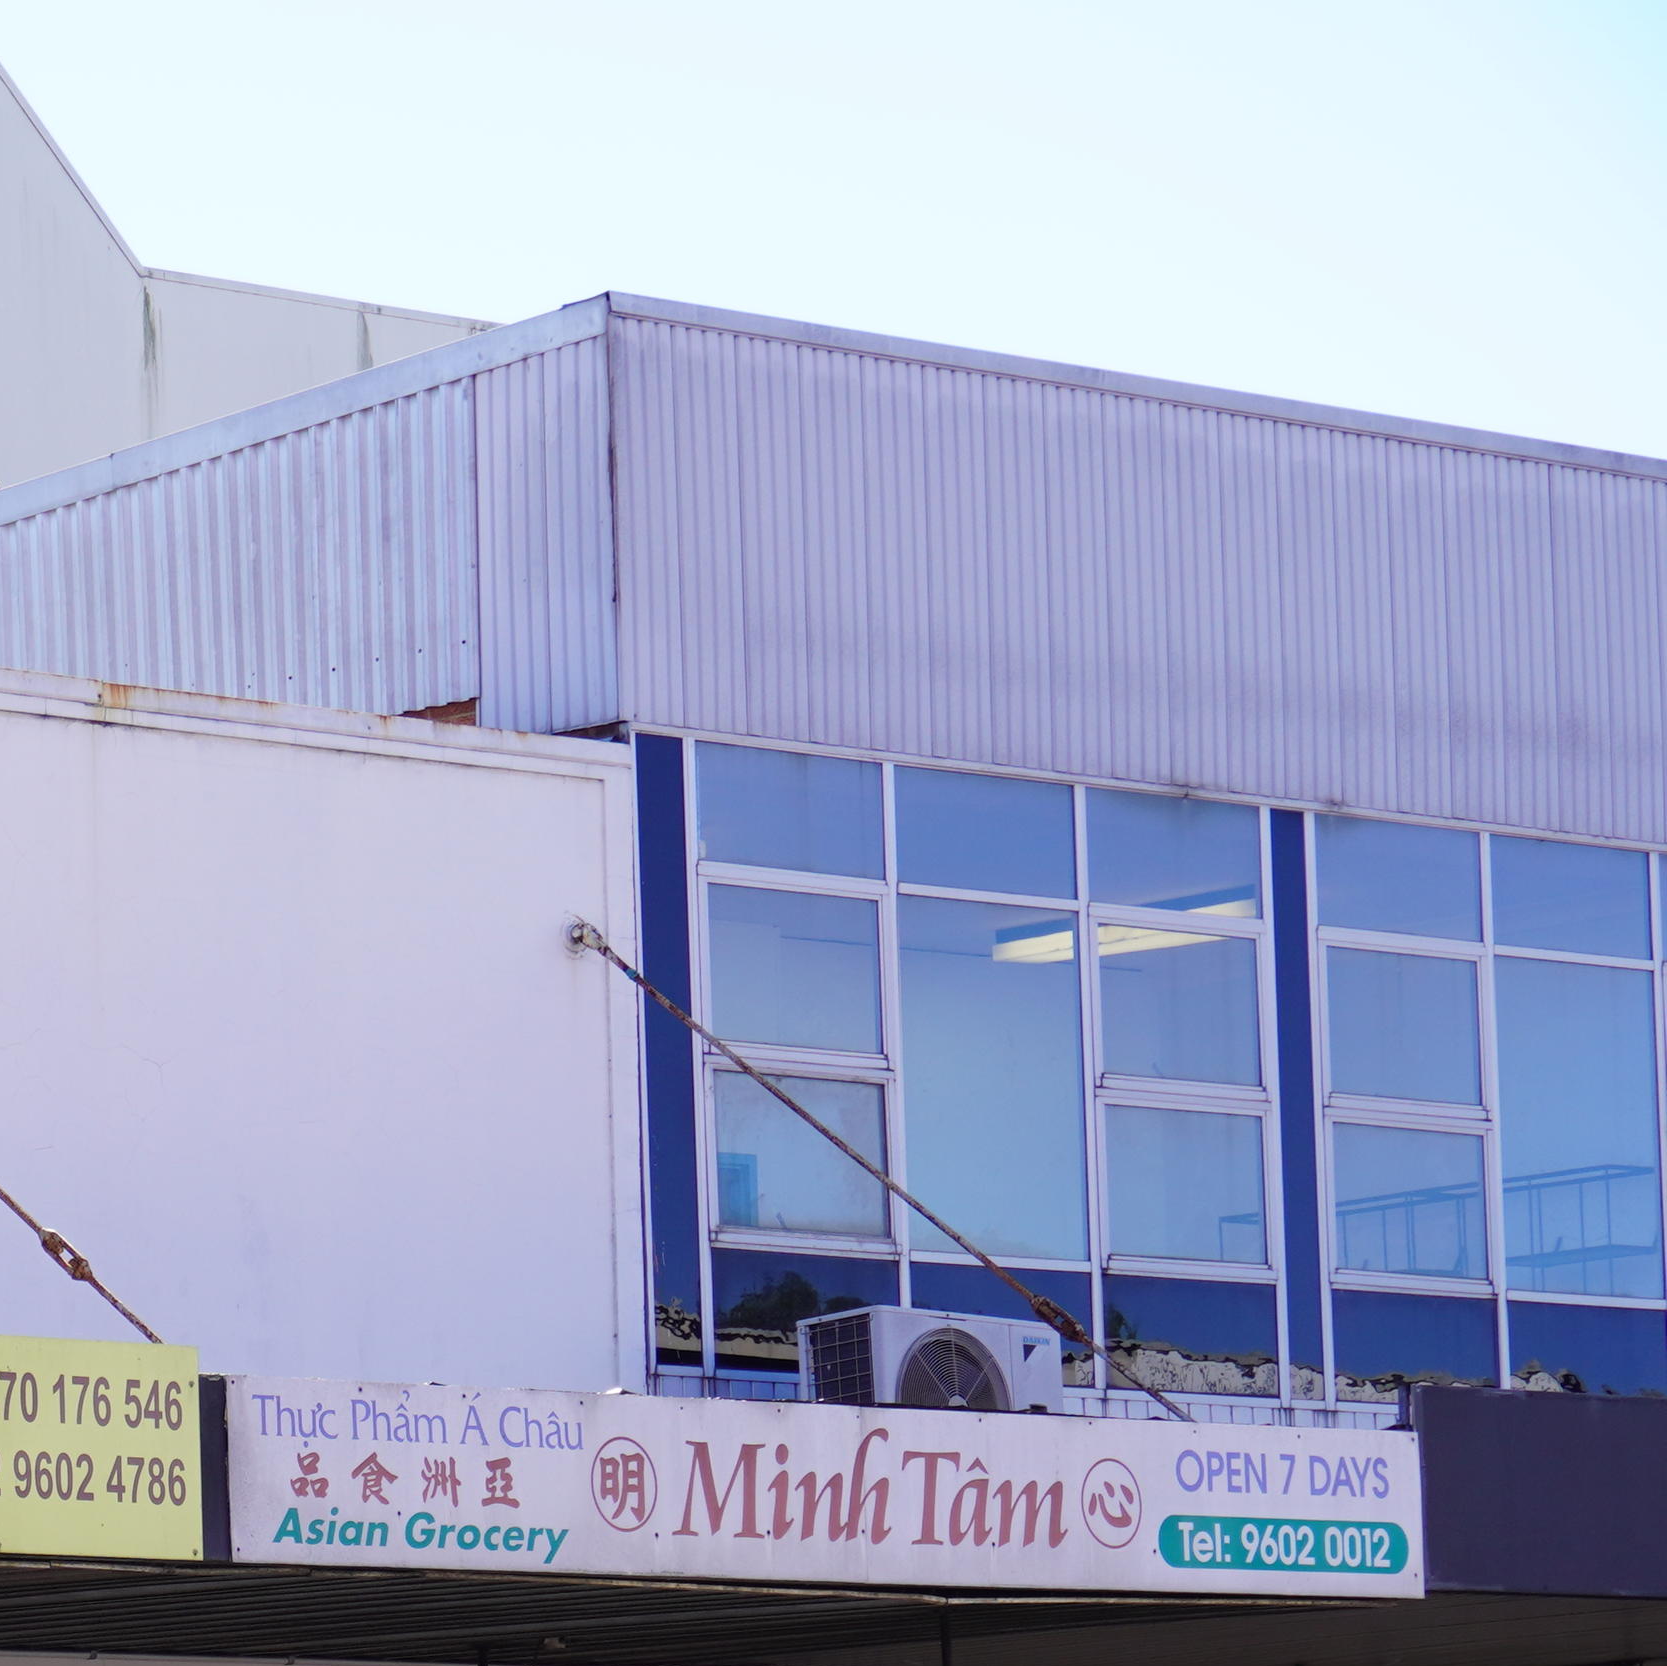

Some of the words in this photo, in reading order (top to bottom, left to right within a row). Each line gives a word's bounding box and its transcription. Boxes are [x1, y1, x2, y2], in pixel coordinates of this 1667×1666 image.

[51, 1375, 111, 1427] 176
[124, 1379, 184, 1431] 546
[252, 1395, 338, 1448] Thực
[351, 1390, 448, 1443] Phẩm
[460, 1393, 488, 1447] Á
[499, 1404, 585, 1451] Châu
[13, 1448, 96, 1502] 9602
[107, 1454, 188, 1507] 4786
[599, 1452, 646, 1523] 明
[671, 1428, 891, 1545] Minh
[902, 1449, 1068, 1549] Tâm
[1176, 1449, 1267, 1495] OPEN
[1279, 1453, 1297, 1496] 7
[1309, 1455, 1390, 1499] DAYS
[273, 1507, 389, 1548] Asian
[405, 1512, 569, 1564] Grocery
[1178, 1521, 1231, 1564] Tel:
[1240, 1522, 1317, 1567] 9602
[1323, 1526, 1391, 1569] 0012
